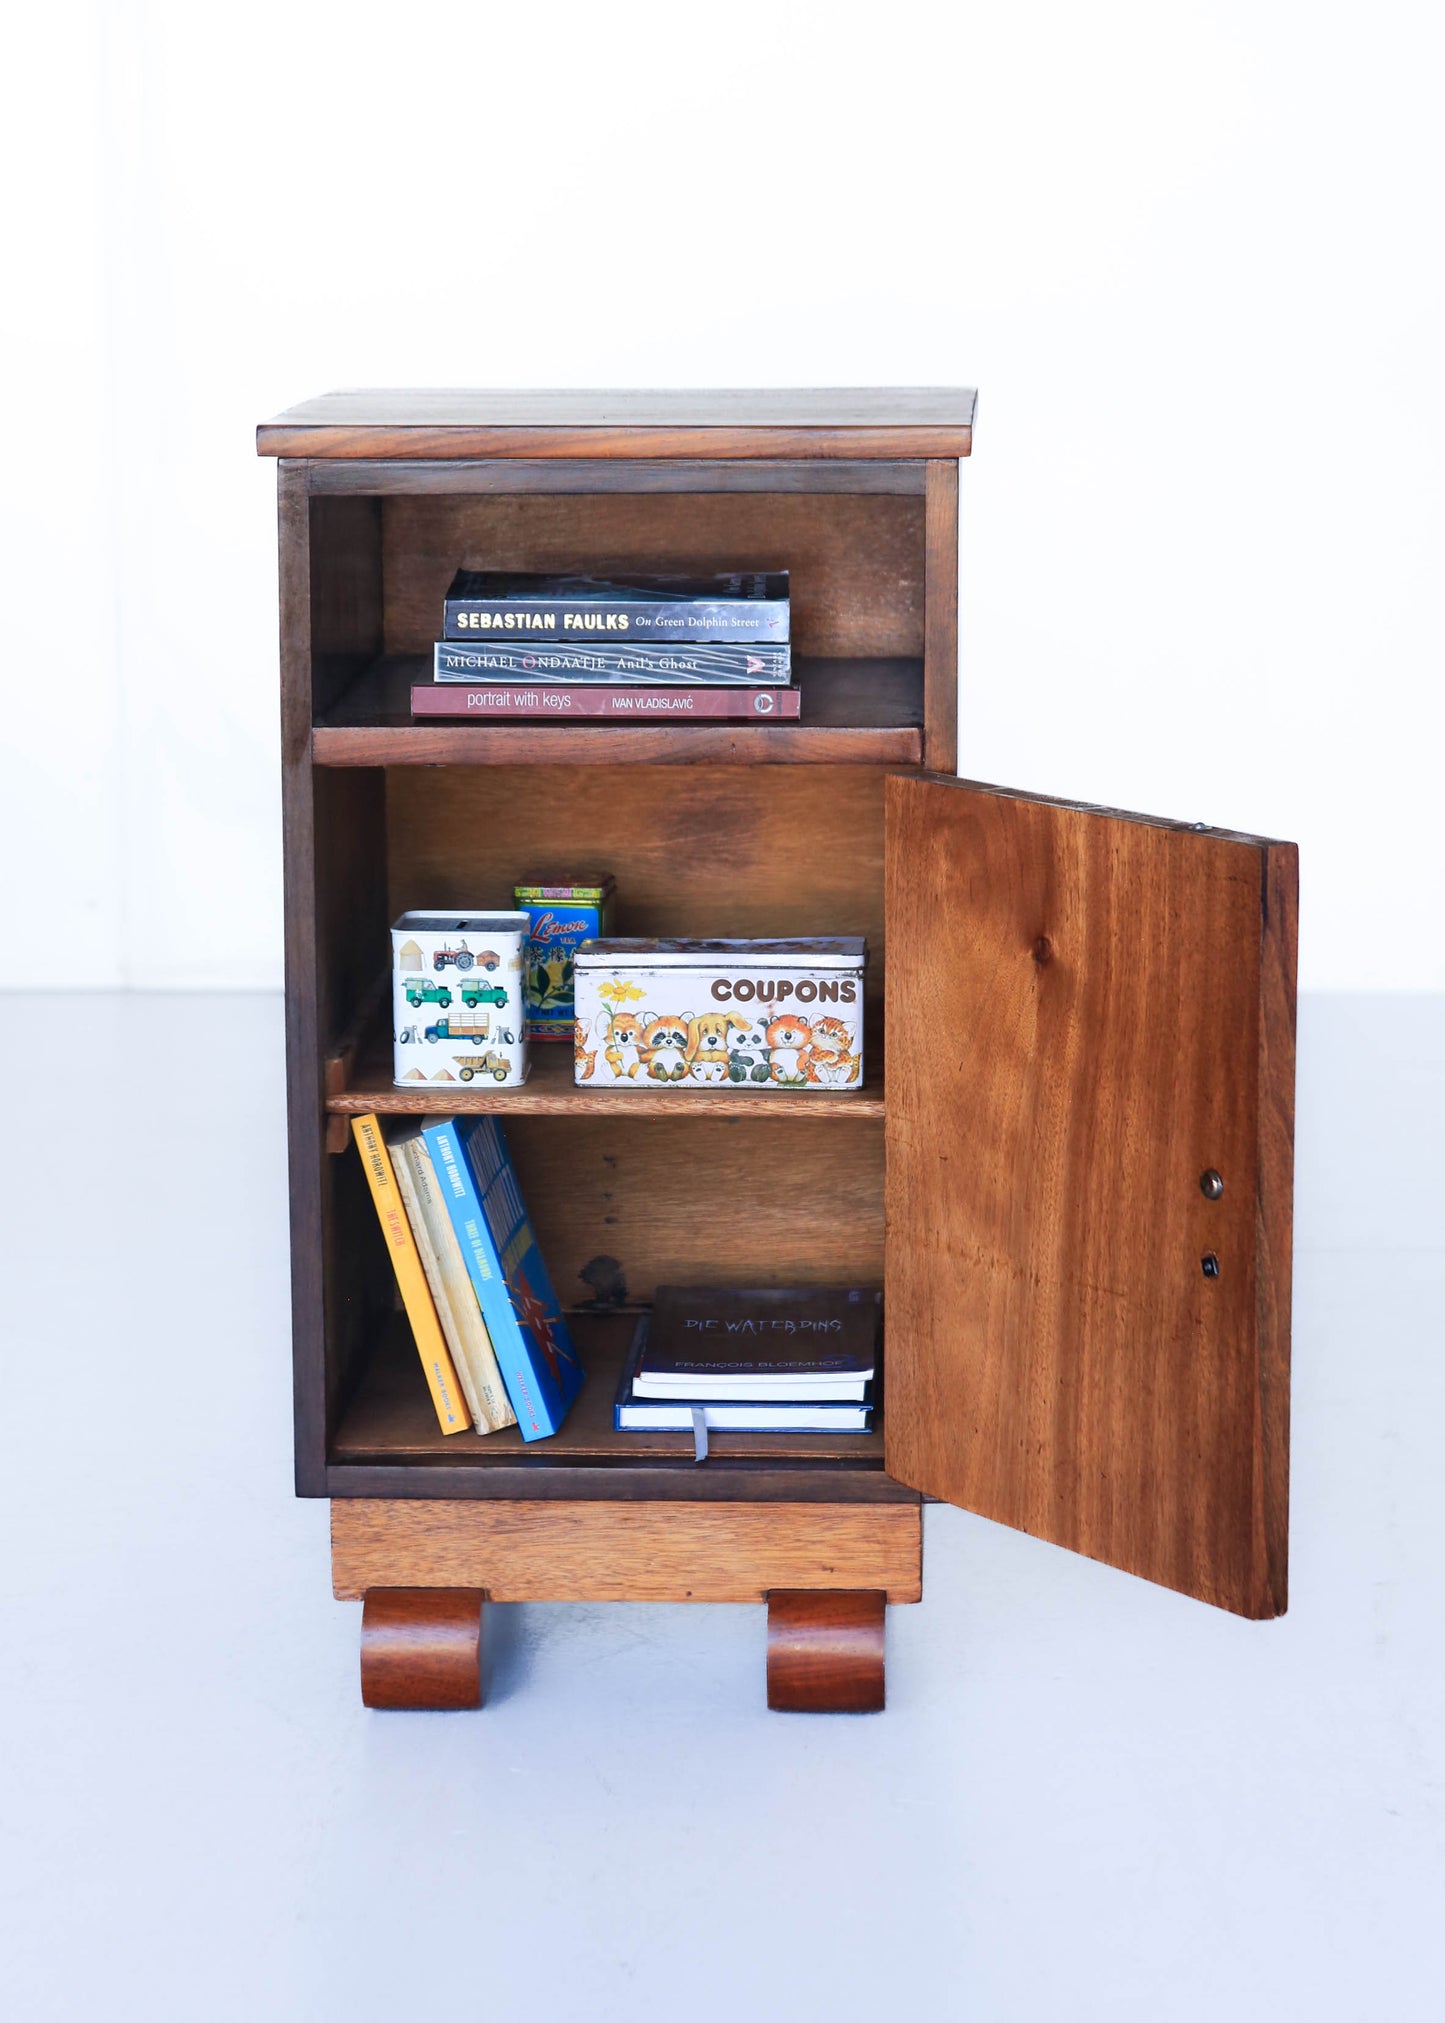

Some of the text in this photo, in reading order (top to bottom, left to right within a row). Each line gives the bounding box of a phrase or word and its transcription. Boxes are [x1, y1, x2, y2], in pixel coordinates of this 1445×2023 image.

[457, 612, 629, 630] SEBASTIAN FAULKS
[635, 616, 759, 629] On Green Dolphin Street
[446, 655, 606, 671] MICHAEL ONDAATJE
[617, 657, 698, 669] Anil's Ghost
[467, 691, 571, 710] portrait with keys
[612, 697, 633, 709] IVAN
[711, 979, 856, 1003] COUPONS
[361, 1124, 388, 1186] ANTHONY HOROWITZ
[436, 1135, 466, 1198] ANTHONY HOROWITZ
[682, 1319, 842, 1336] DIE WATERDING
